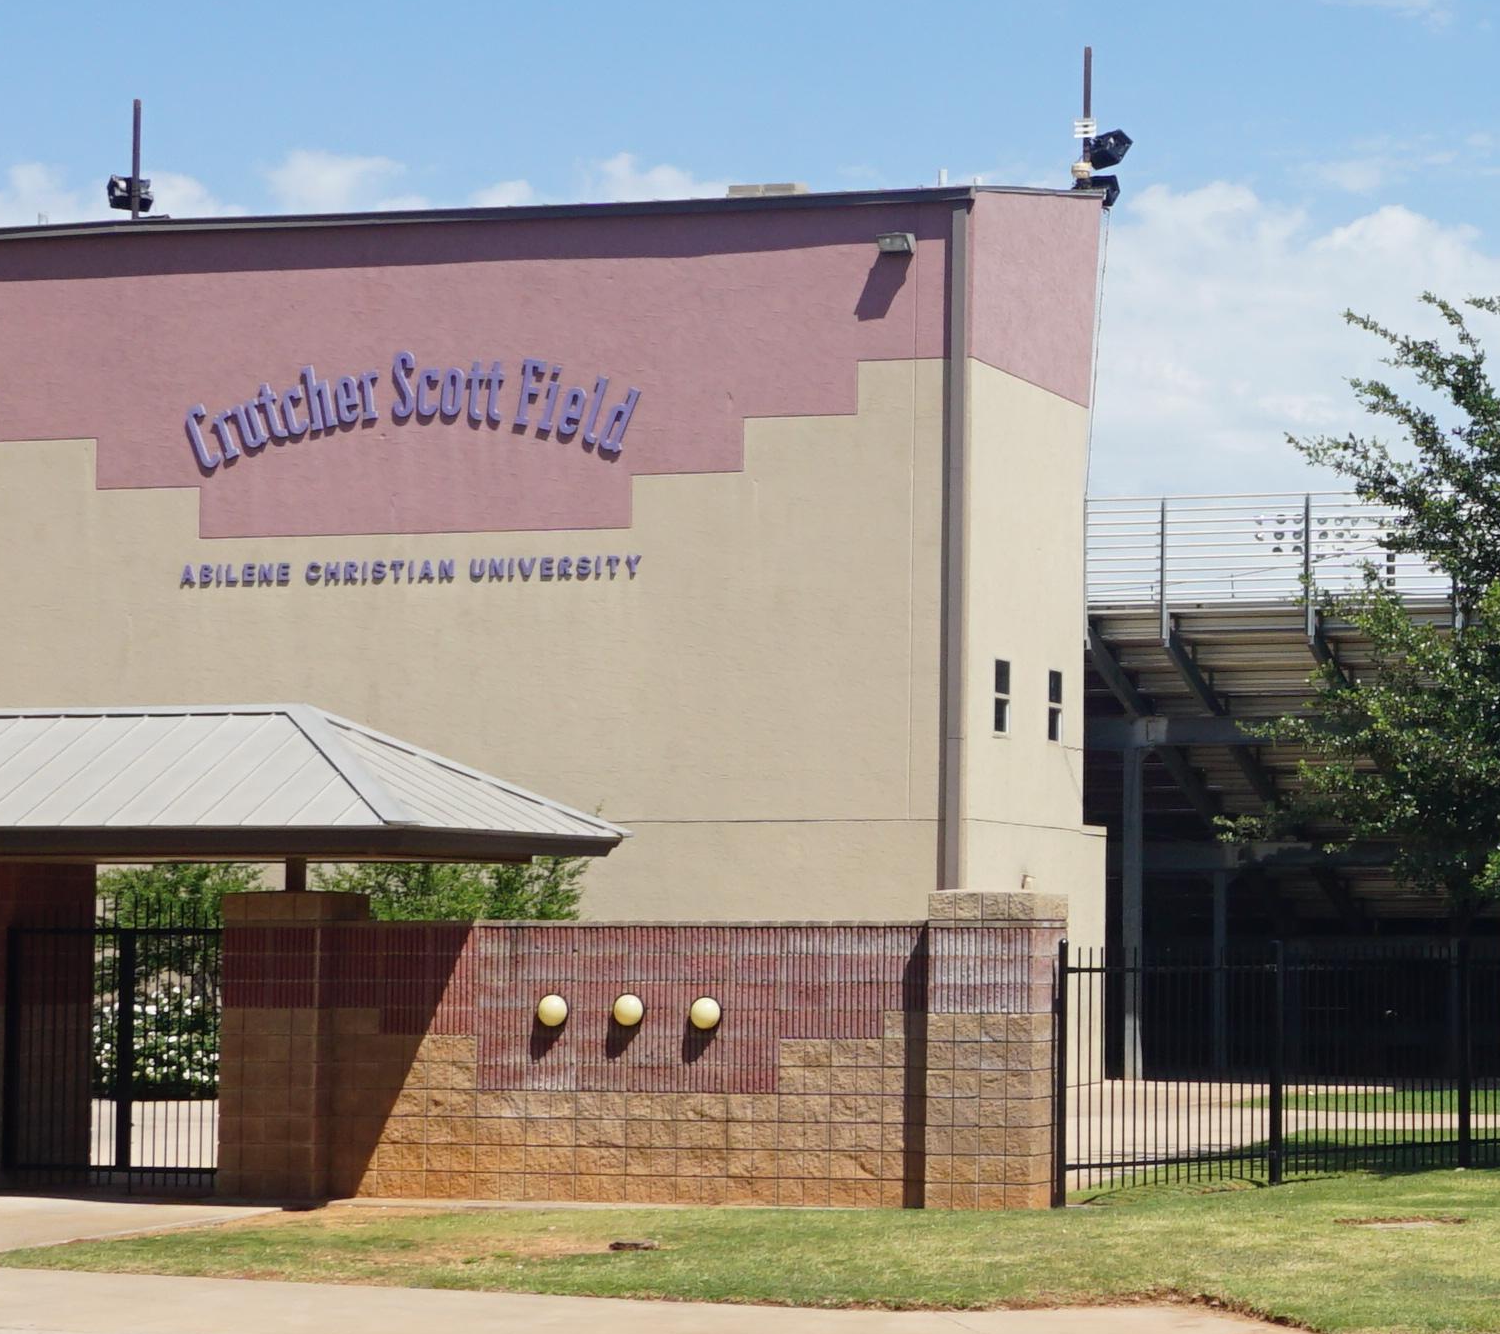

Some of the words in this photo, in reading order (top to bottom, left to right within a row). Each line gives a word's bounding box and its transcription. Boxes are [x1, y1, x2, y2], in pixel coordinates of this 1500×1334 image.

[186, 364, 379, 471] Crutcher
[392, 351, 504, 424] Scott
[513, 358, 642, 455] Field
[180, 562, 291, 588] ABILENE
[305, 559, 456, 584] CHRISTIAN
[469, 554, 642, 581] UNIVERSITY
